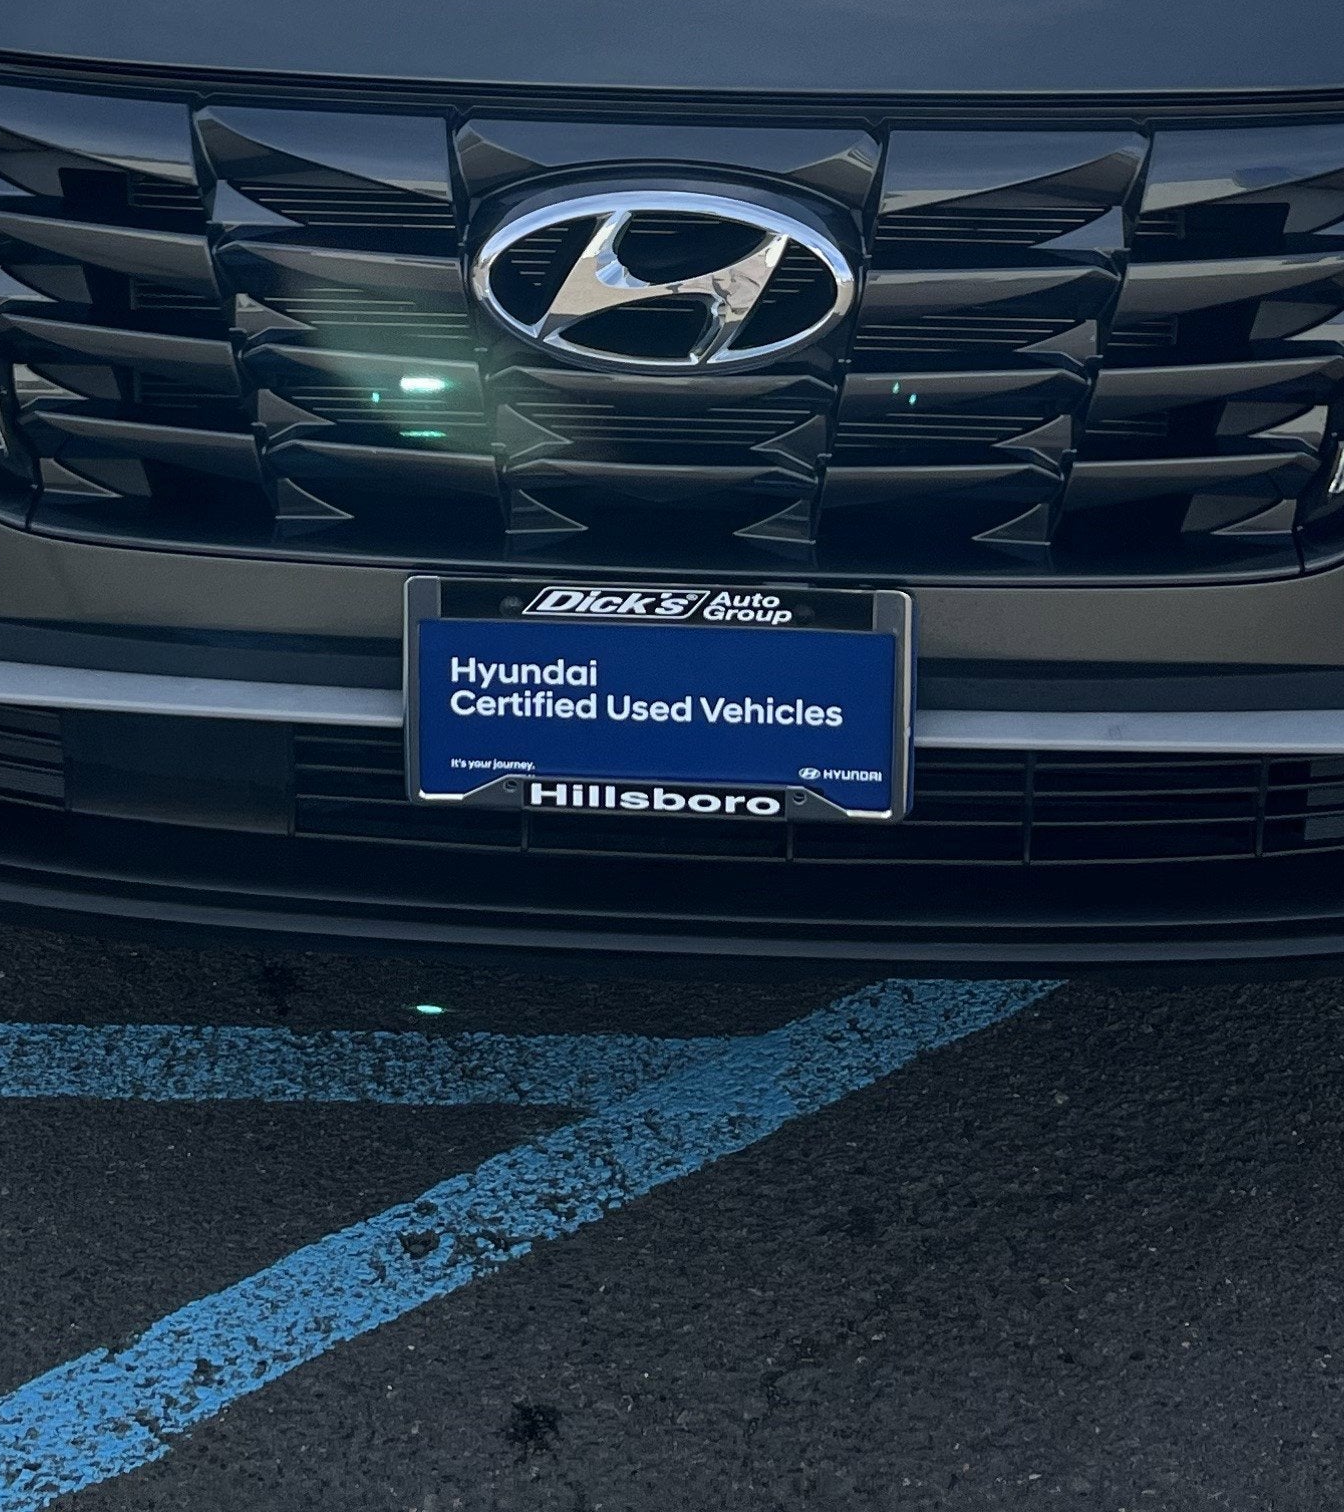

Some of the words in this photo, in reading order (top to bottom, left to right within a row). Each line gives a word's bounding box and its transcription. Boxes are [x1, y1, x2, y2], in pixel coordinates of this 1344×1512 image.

[709, 591, 781, 609] Auto
[703, 605, 793, 625] Group
[450, 656, 599, 689] Hyundai
[449, 689, 598, 721] Certified
[607, 694, 693, 723] Used
[700, 696, 844, 728] Vehicles
[451, 758, 467, 768] It's
[468, 760, 492, 770] your
[823, 769, 883, 782] HYUNDAI
[530, 782, 781, 817] Hillsboro
